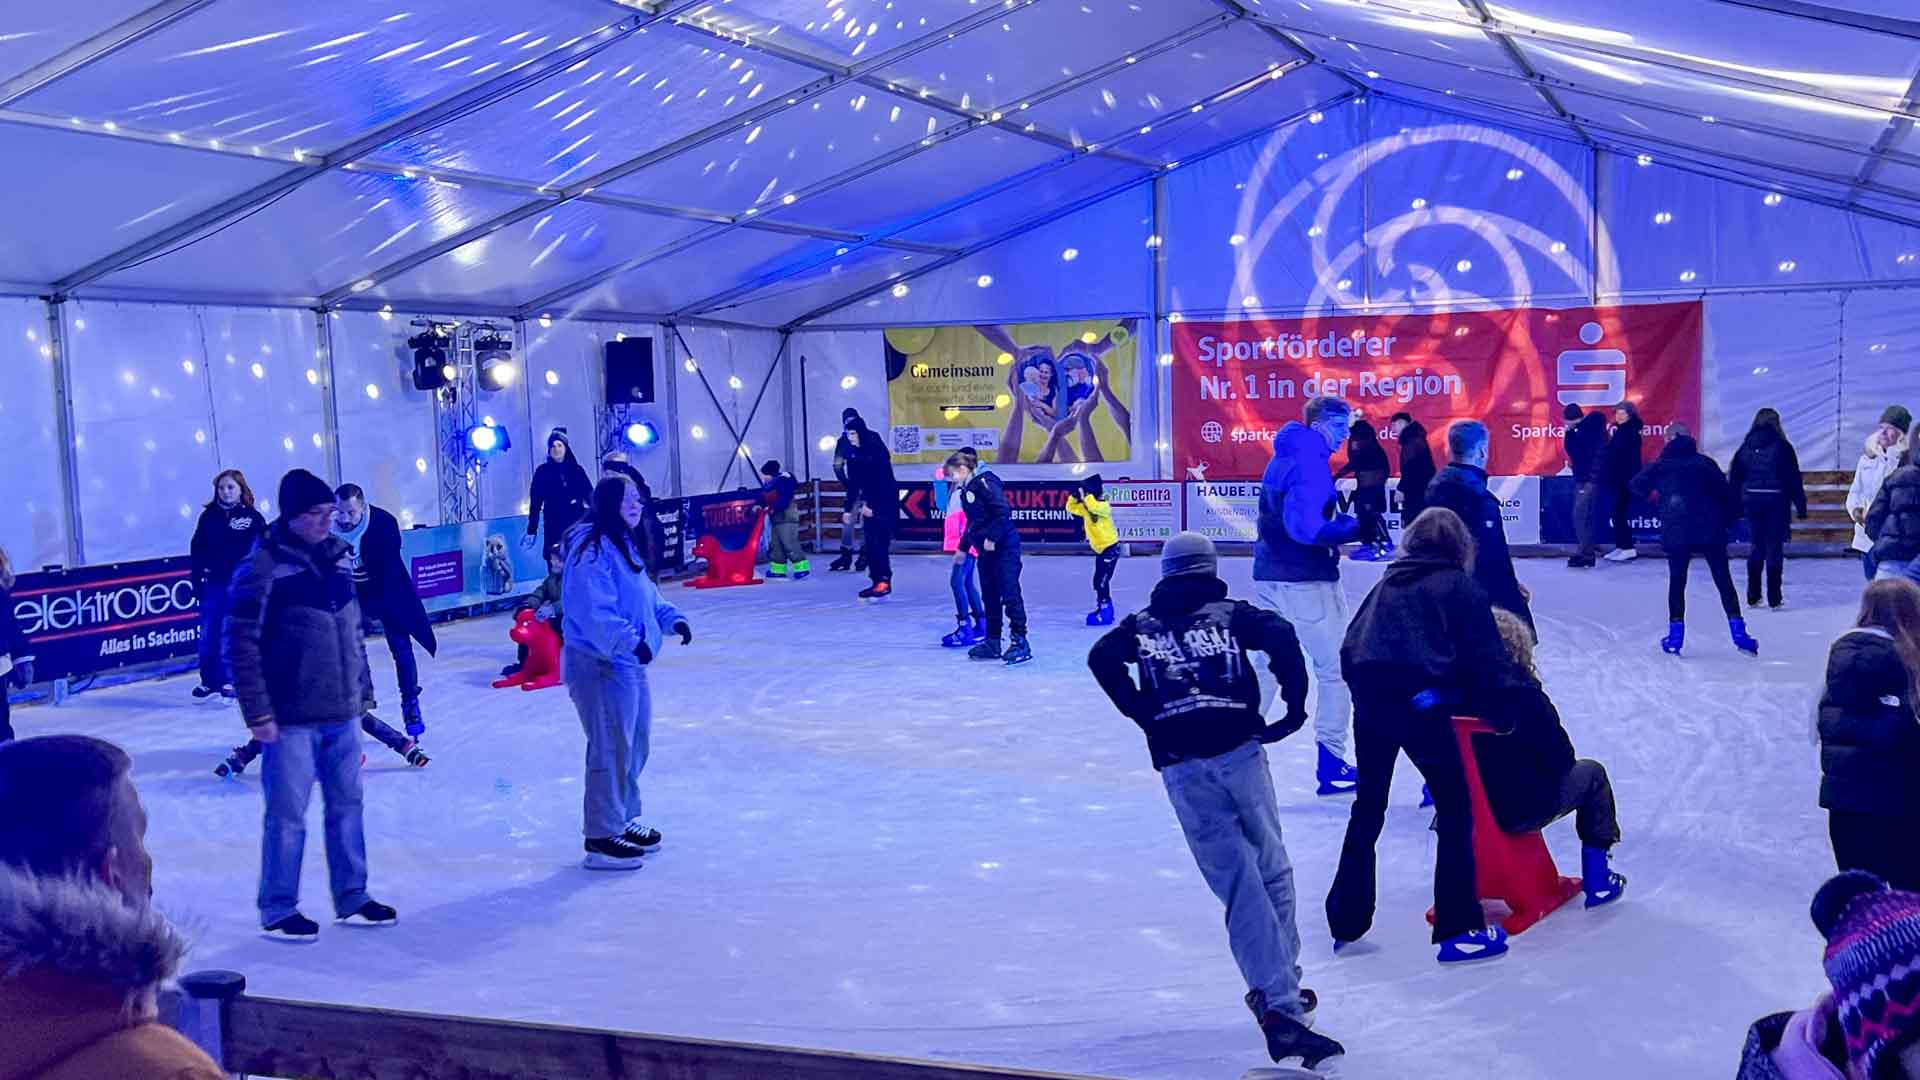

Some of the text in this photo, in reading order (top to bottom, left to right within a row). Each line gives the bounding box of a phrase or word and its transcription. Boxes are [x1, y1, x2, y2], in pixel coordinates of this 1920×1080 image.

[1198, 331, 1397, 367] Sportförderer
[909, 363, 994, 379] Gemeinsam
[1200, 368, 1463, 403] Nr. 1 in der Region
[1230, 426, 1278, 444] sparka
[1511, 422, 1567, 440] Sparka
[1008, 510, 1074, 521] BETECHNIK
[14, 579, 199, 634] elektrotec
[100, 634, 131, 656] Alles
[133, 633, 146, 650] in
[148, 628, 195, 648] Sachen
